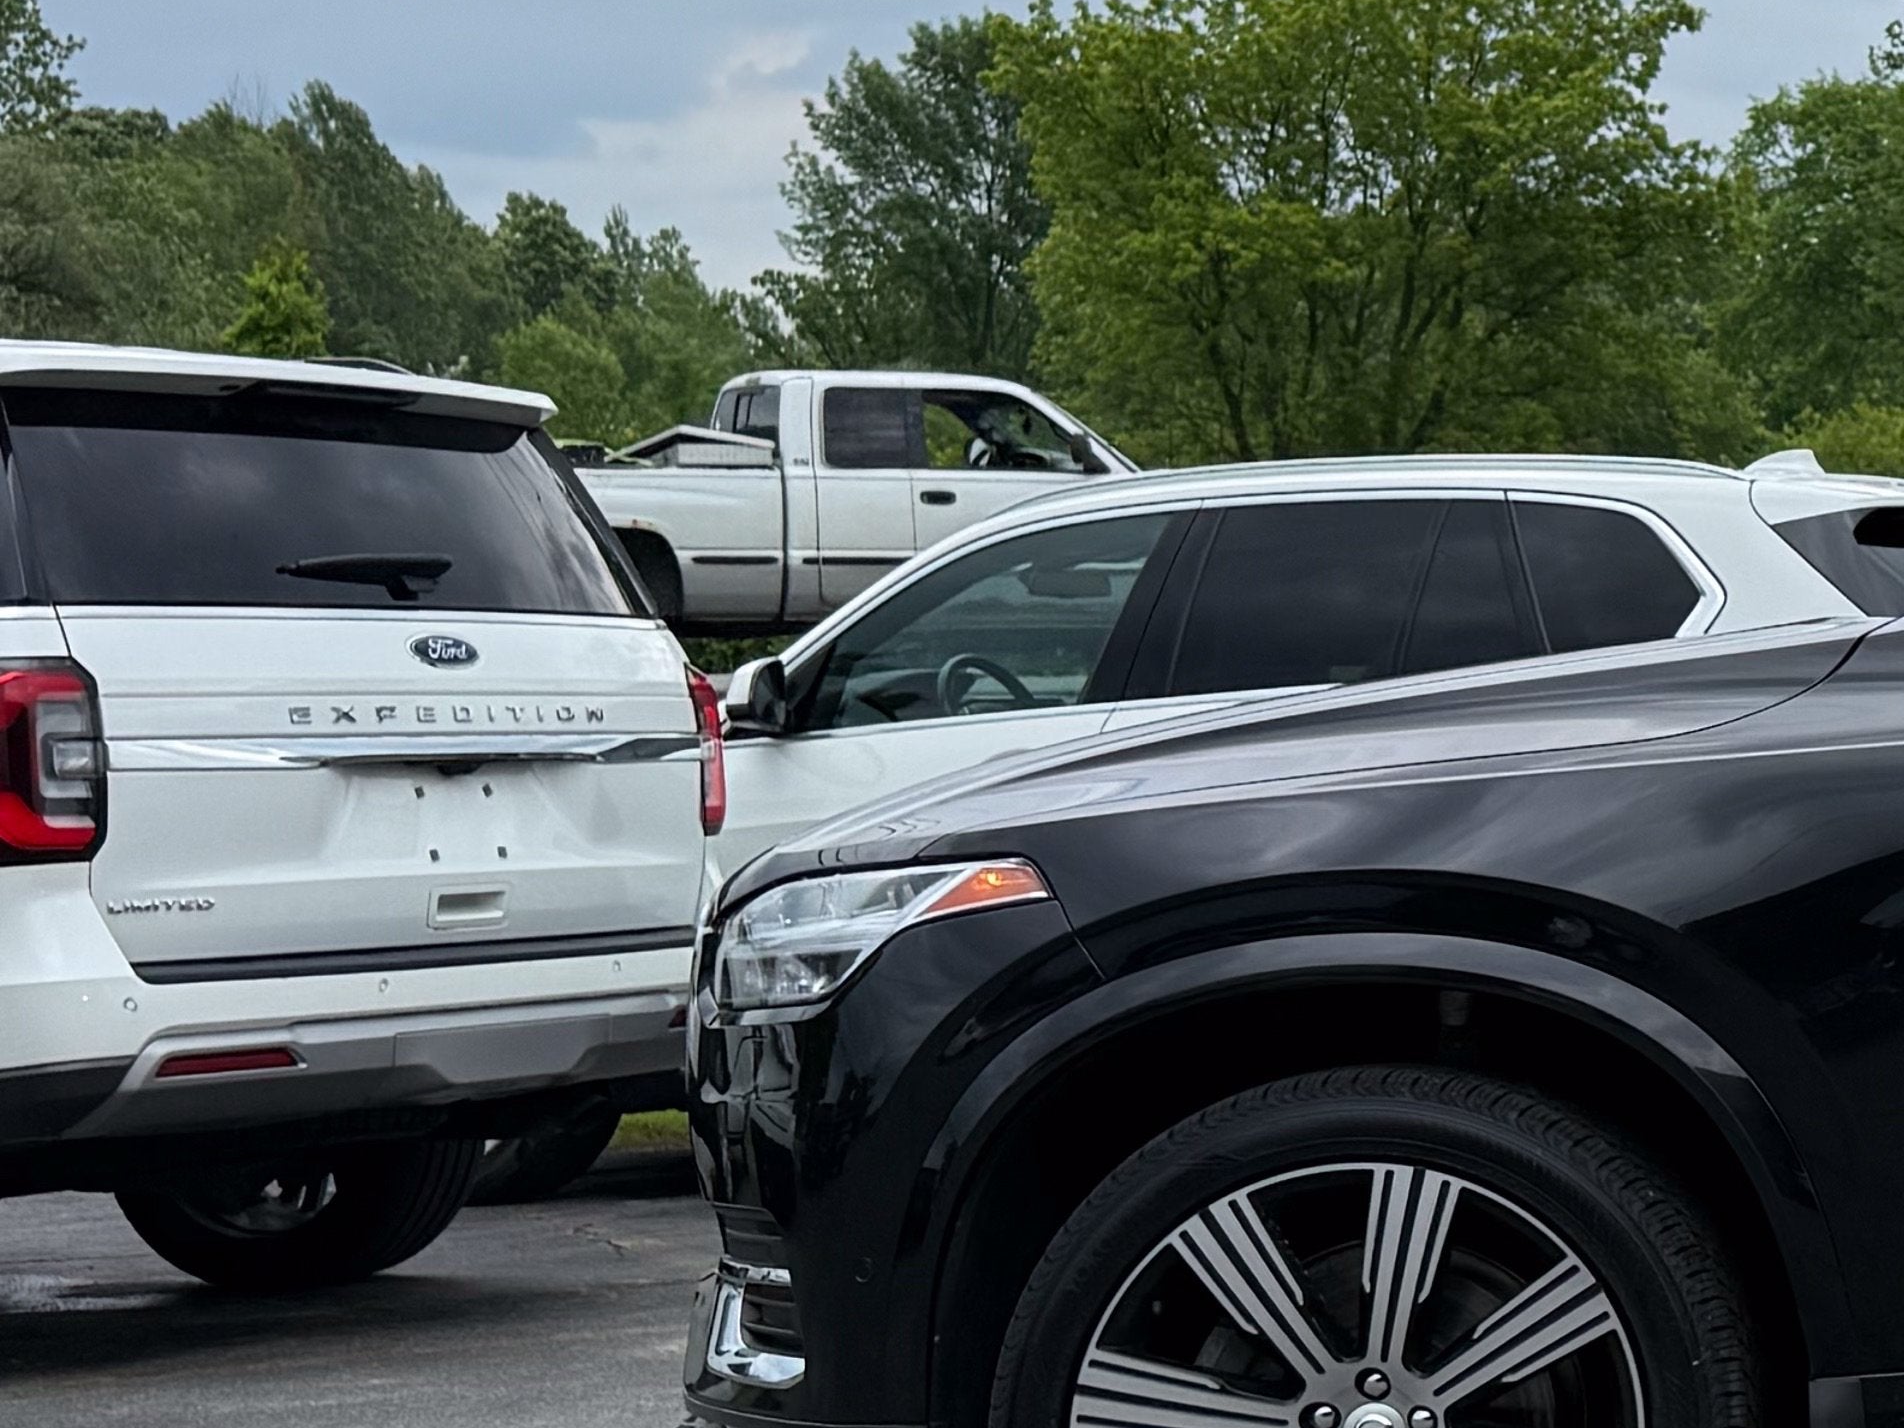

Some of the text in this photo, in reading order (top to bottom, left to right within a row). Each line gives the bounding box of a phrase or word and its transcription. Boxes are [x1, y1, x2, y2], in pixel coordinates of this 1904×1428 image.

[428, 638, 468, 660] Ford
[288, 706, 604, 725] EXPEDITION
[106, 898, 215, 914] LIMITED
